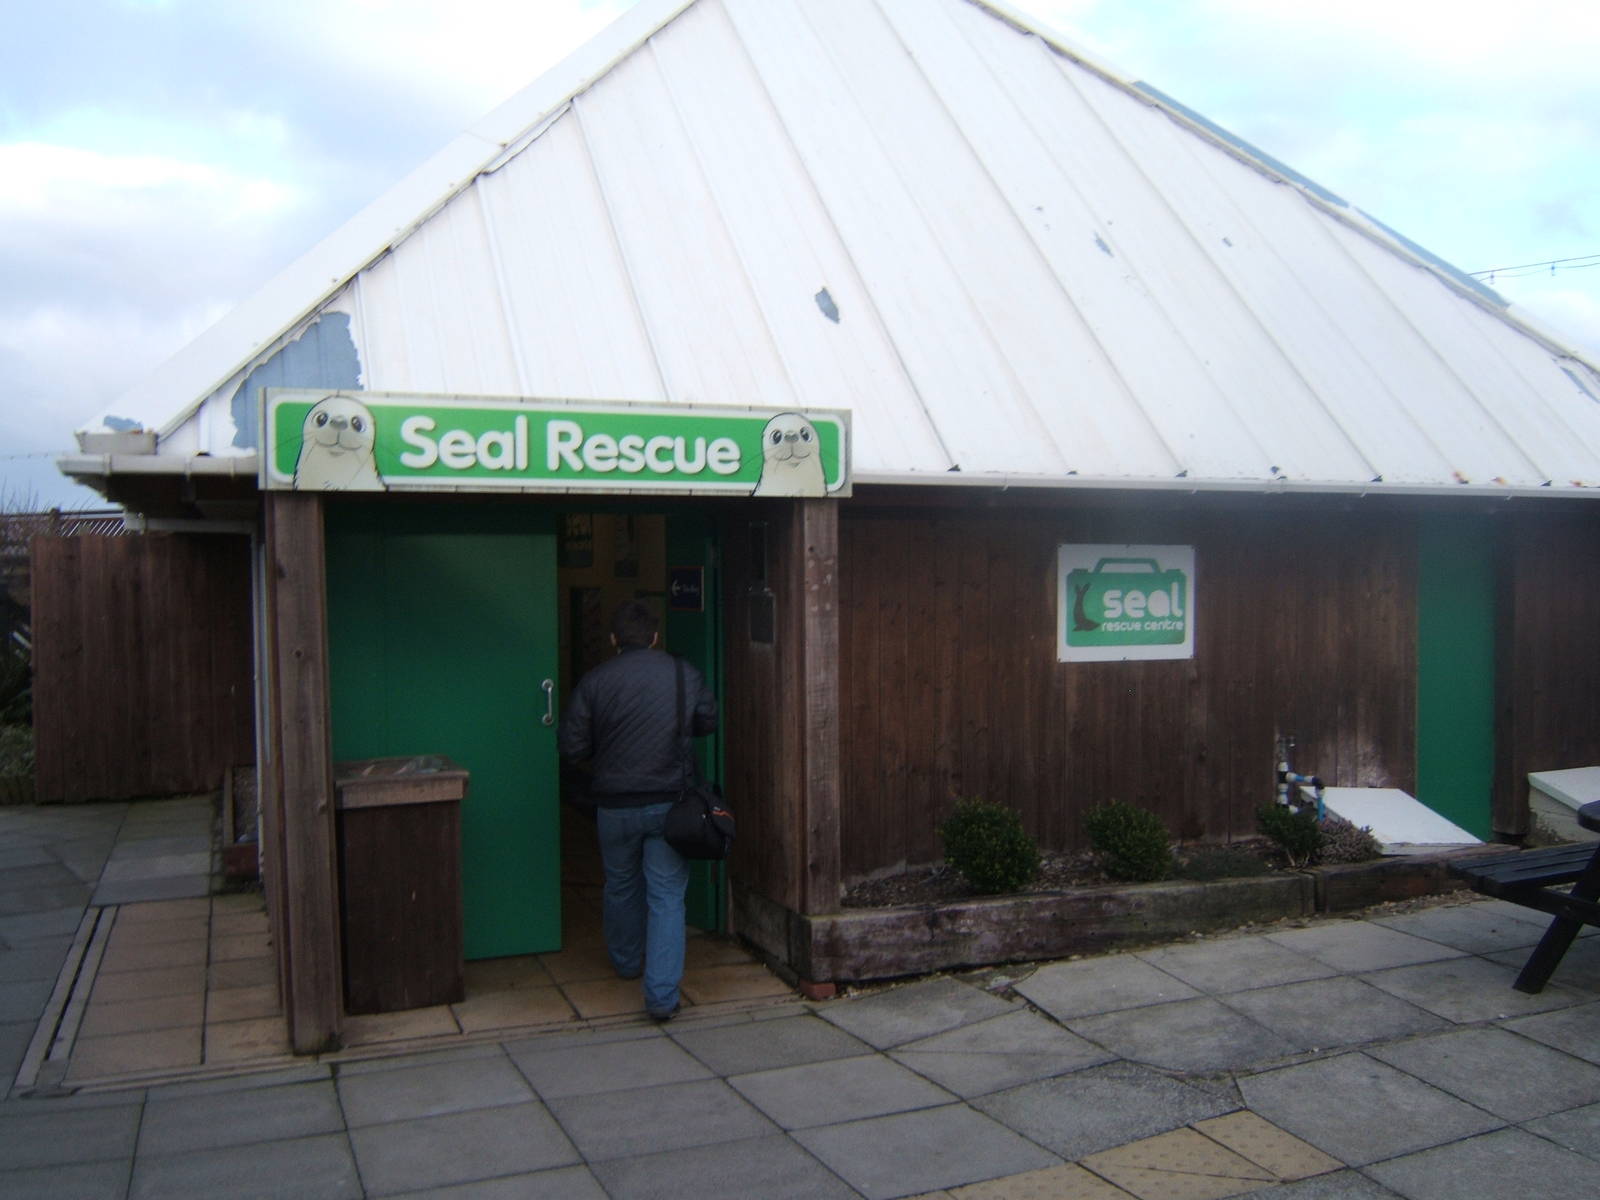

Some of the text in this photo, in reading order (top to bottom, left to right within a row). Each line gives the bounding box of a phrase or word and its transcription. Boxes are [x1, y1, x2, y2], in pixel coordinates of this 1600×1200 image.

[400, 414, 742, 475] Seal Rescue
[1102, 581, 1184, 618] seal
[1101, 618, 1184, 632] rescue centre
